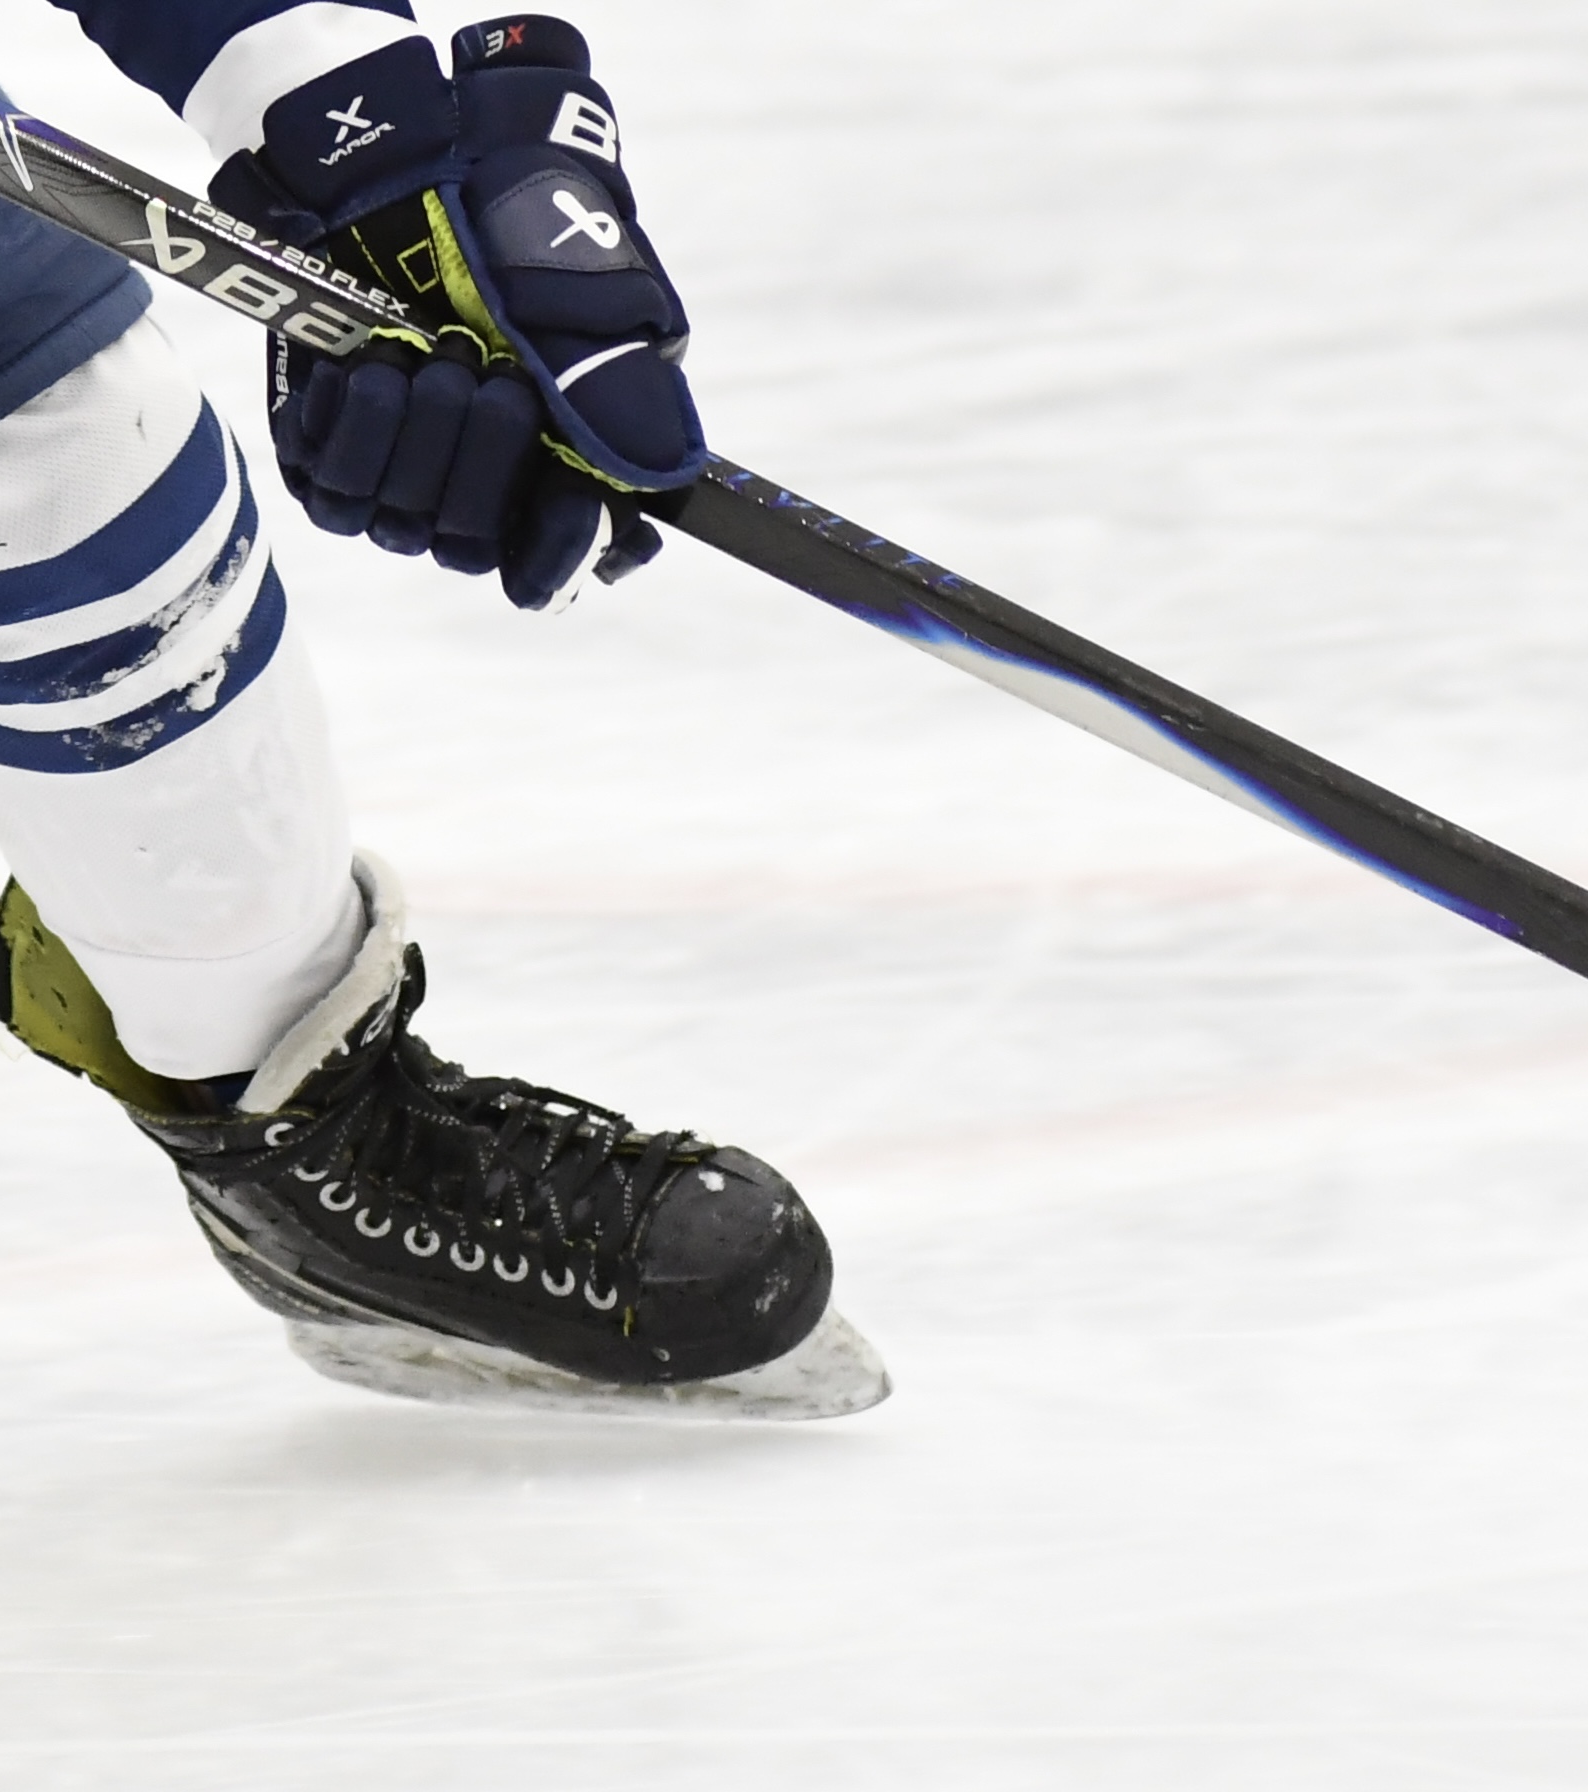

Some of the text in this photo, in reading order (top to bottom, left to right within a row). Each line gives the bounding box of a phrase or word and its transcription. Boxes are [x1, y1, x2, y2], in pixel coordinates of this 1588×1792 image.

[318, 122, 396, 166] VAPOR
[548, 91, 618, 163] B
[192, 201, 257, 241] P28
[281, 245, 326, 275] 20
[330, 269, 410, 317] FLEX
[202, 263, 373, 356] BA
